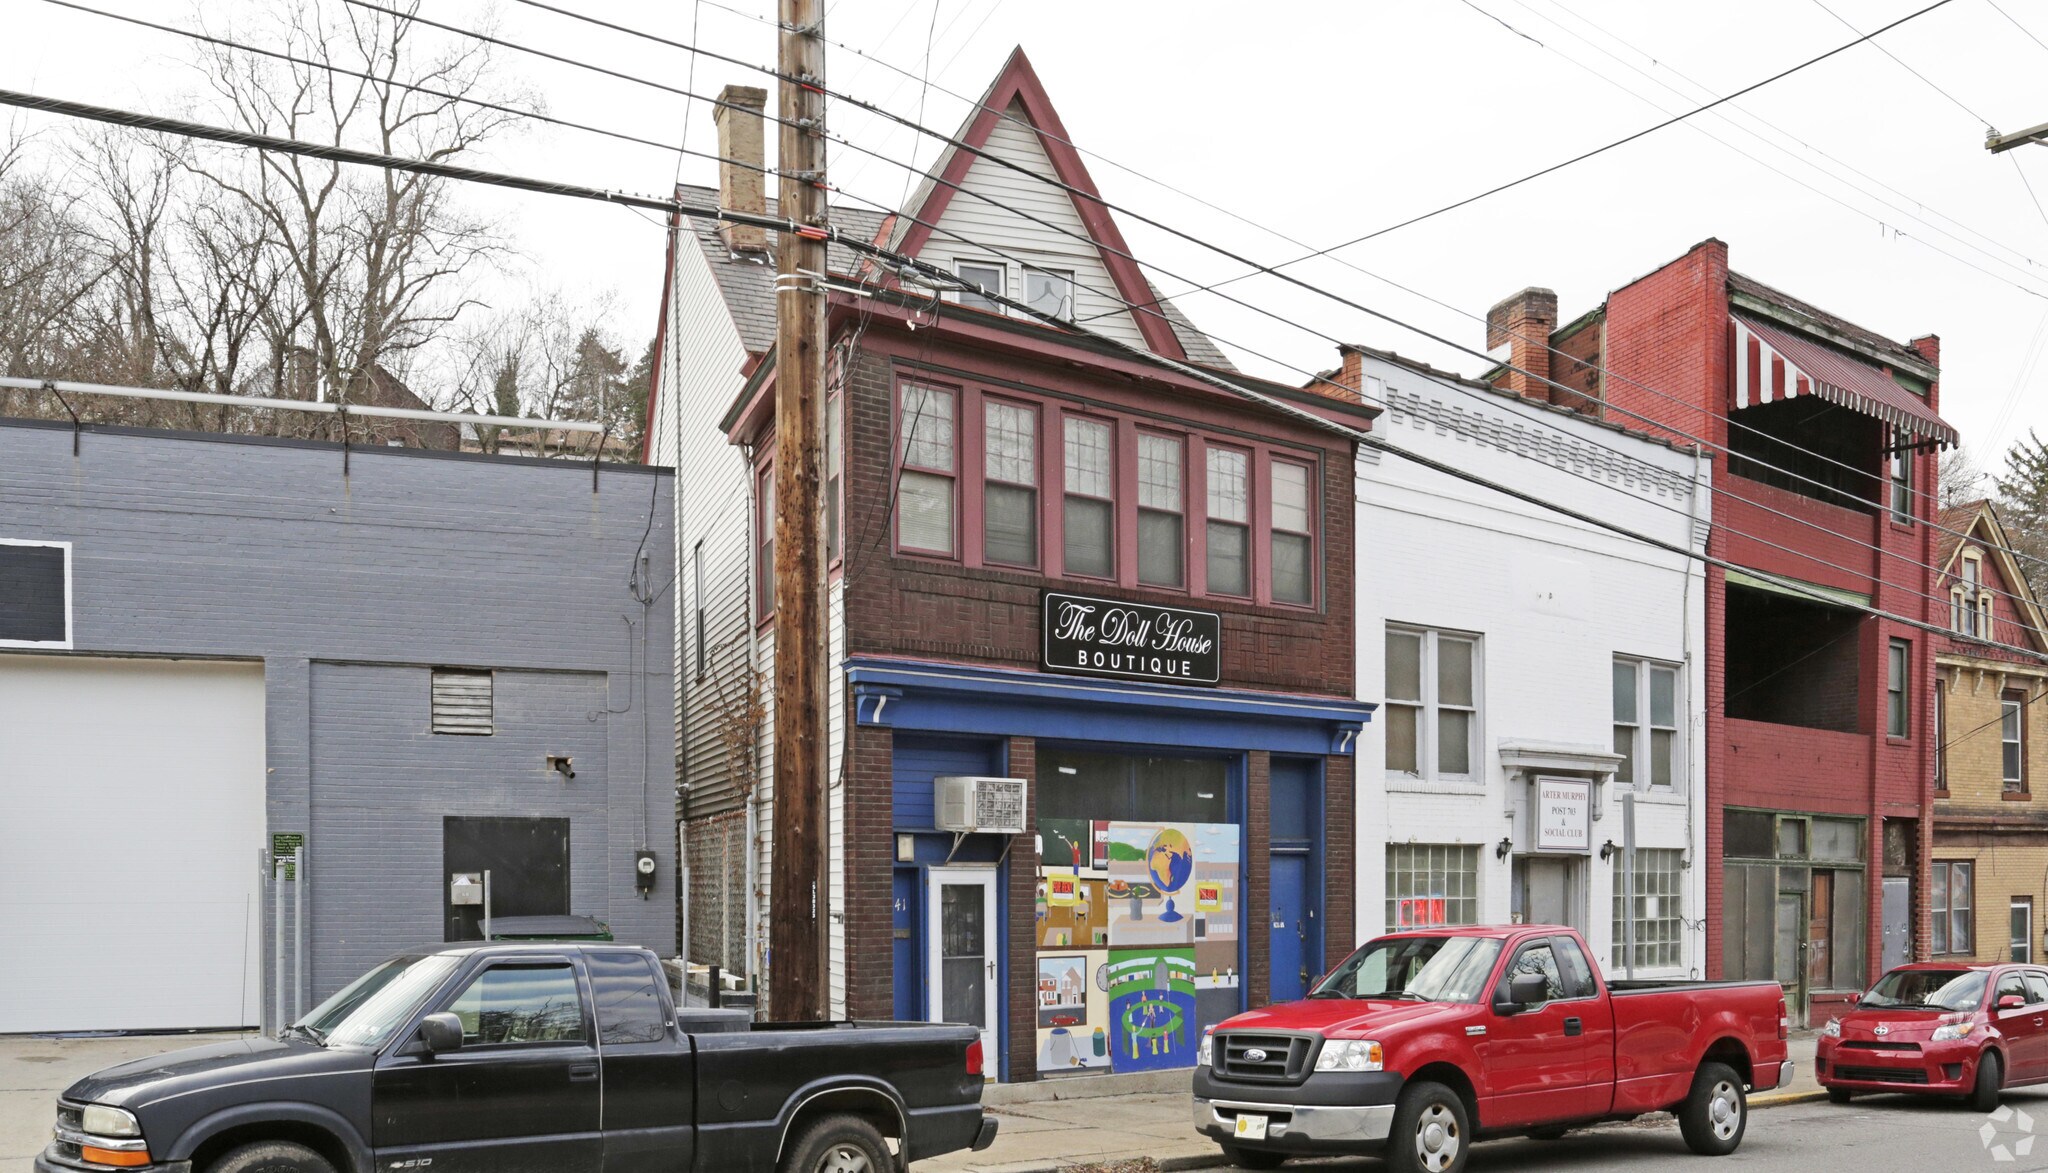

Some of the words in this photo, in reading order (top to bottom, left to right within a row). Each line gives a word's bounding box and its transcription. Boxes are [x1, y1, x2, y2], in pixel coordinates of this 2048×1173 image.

[1055, 601, 1096, 641] The
[1099, 608, 1151, 648] Doll
[1151, 612, 1212, 655] House
[1078, 650, 1191, 676] BOUTIQUE
[1562, 791, 1586, 801] MURPHY
[1551, 806, 1566, 816] POST
[1567, 807, 1576, 816] 703
[1544, 828, 1566, 838] SOCIAL
[1566, 829, 1583, 838] CLUB
[894, 898, 906, 911] 41
[404, 1158, 433, 1168] S10
